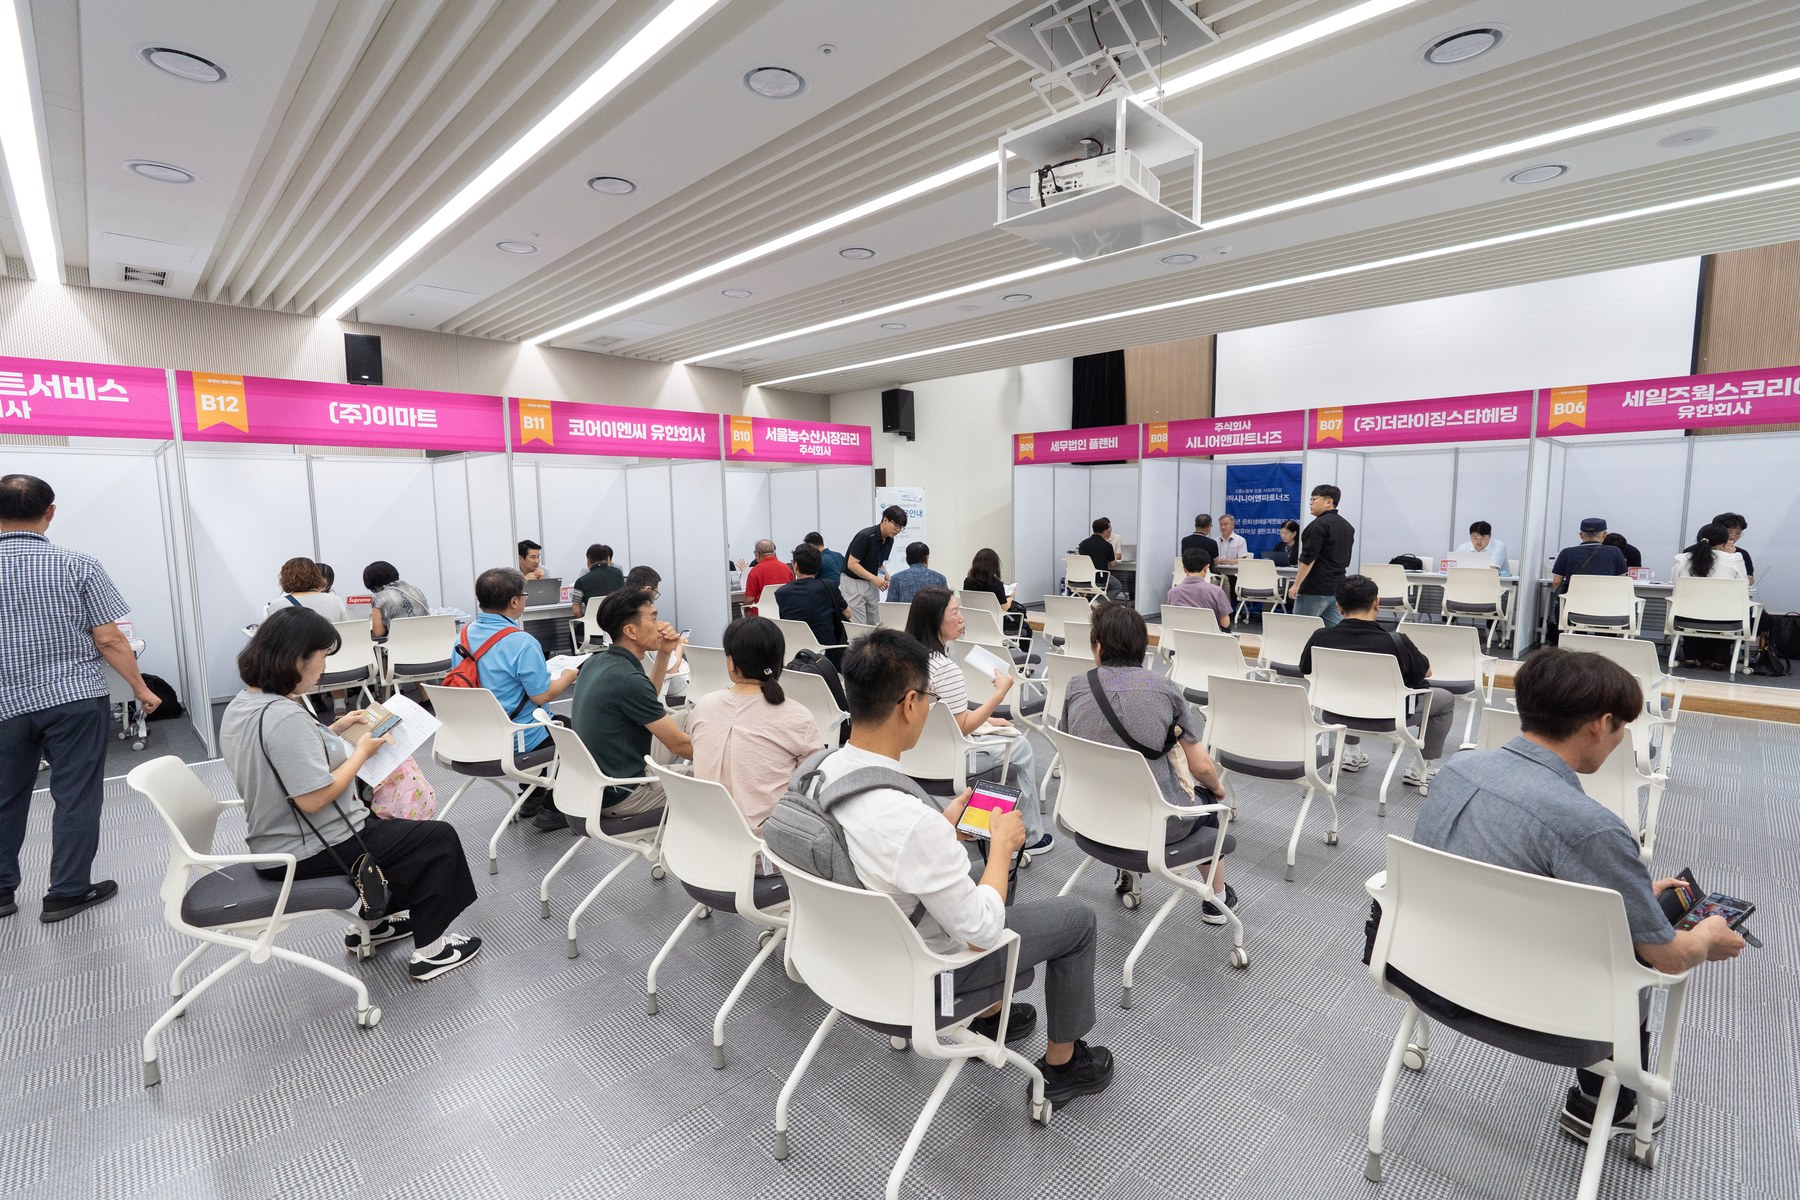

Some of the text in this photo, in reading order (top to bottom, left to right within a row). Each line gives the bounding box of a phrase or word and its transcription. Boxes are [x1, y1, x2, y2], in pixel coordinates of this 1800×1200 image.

[0, 400, 32, 419] 사
[201, 394, 240, 413] B12
[1553, 402, 1586, 416] B06
[1677, 401, 1752, 419] 유한회사
[329, 401, 438, 428] (주)이마트
[1354, 405, 1518, 432] (주)더라이징스타헤딩
[523, 415, 545, 430] B11
[1214, 420, 1251, 432] 주식회사
[1319, 419, 1343, 431] B07
[568, 418, 706, 443] 코어이엔씨 유한회사
[733, 430, 751, 442] B10
[765, 426, 860, 446] 서울농수산시장관리
[1150, 433, 1168, 443] B08
[1020, 443, 1034, 452] B09
[1050, 437, 1119, 452] 세무법인 플랜비
[1185, 431, 1282, 449] 시니어앤파트너즈
[799, 444, 831, 457] 주식회사
